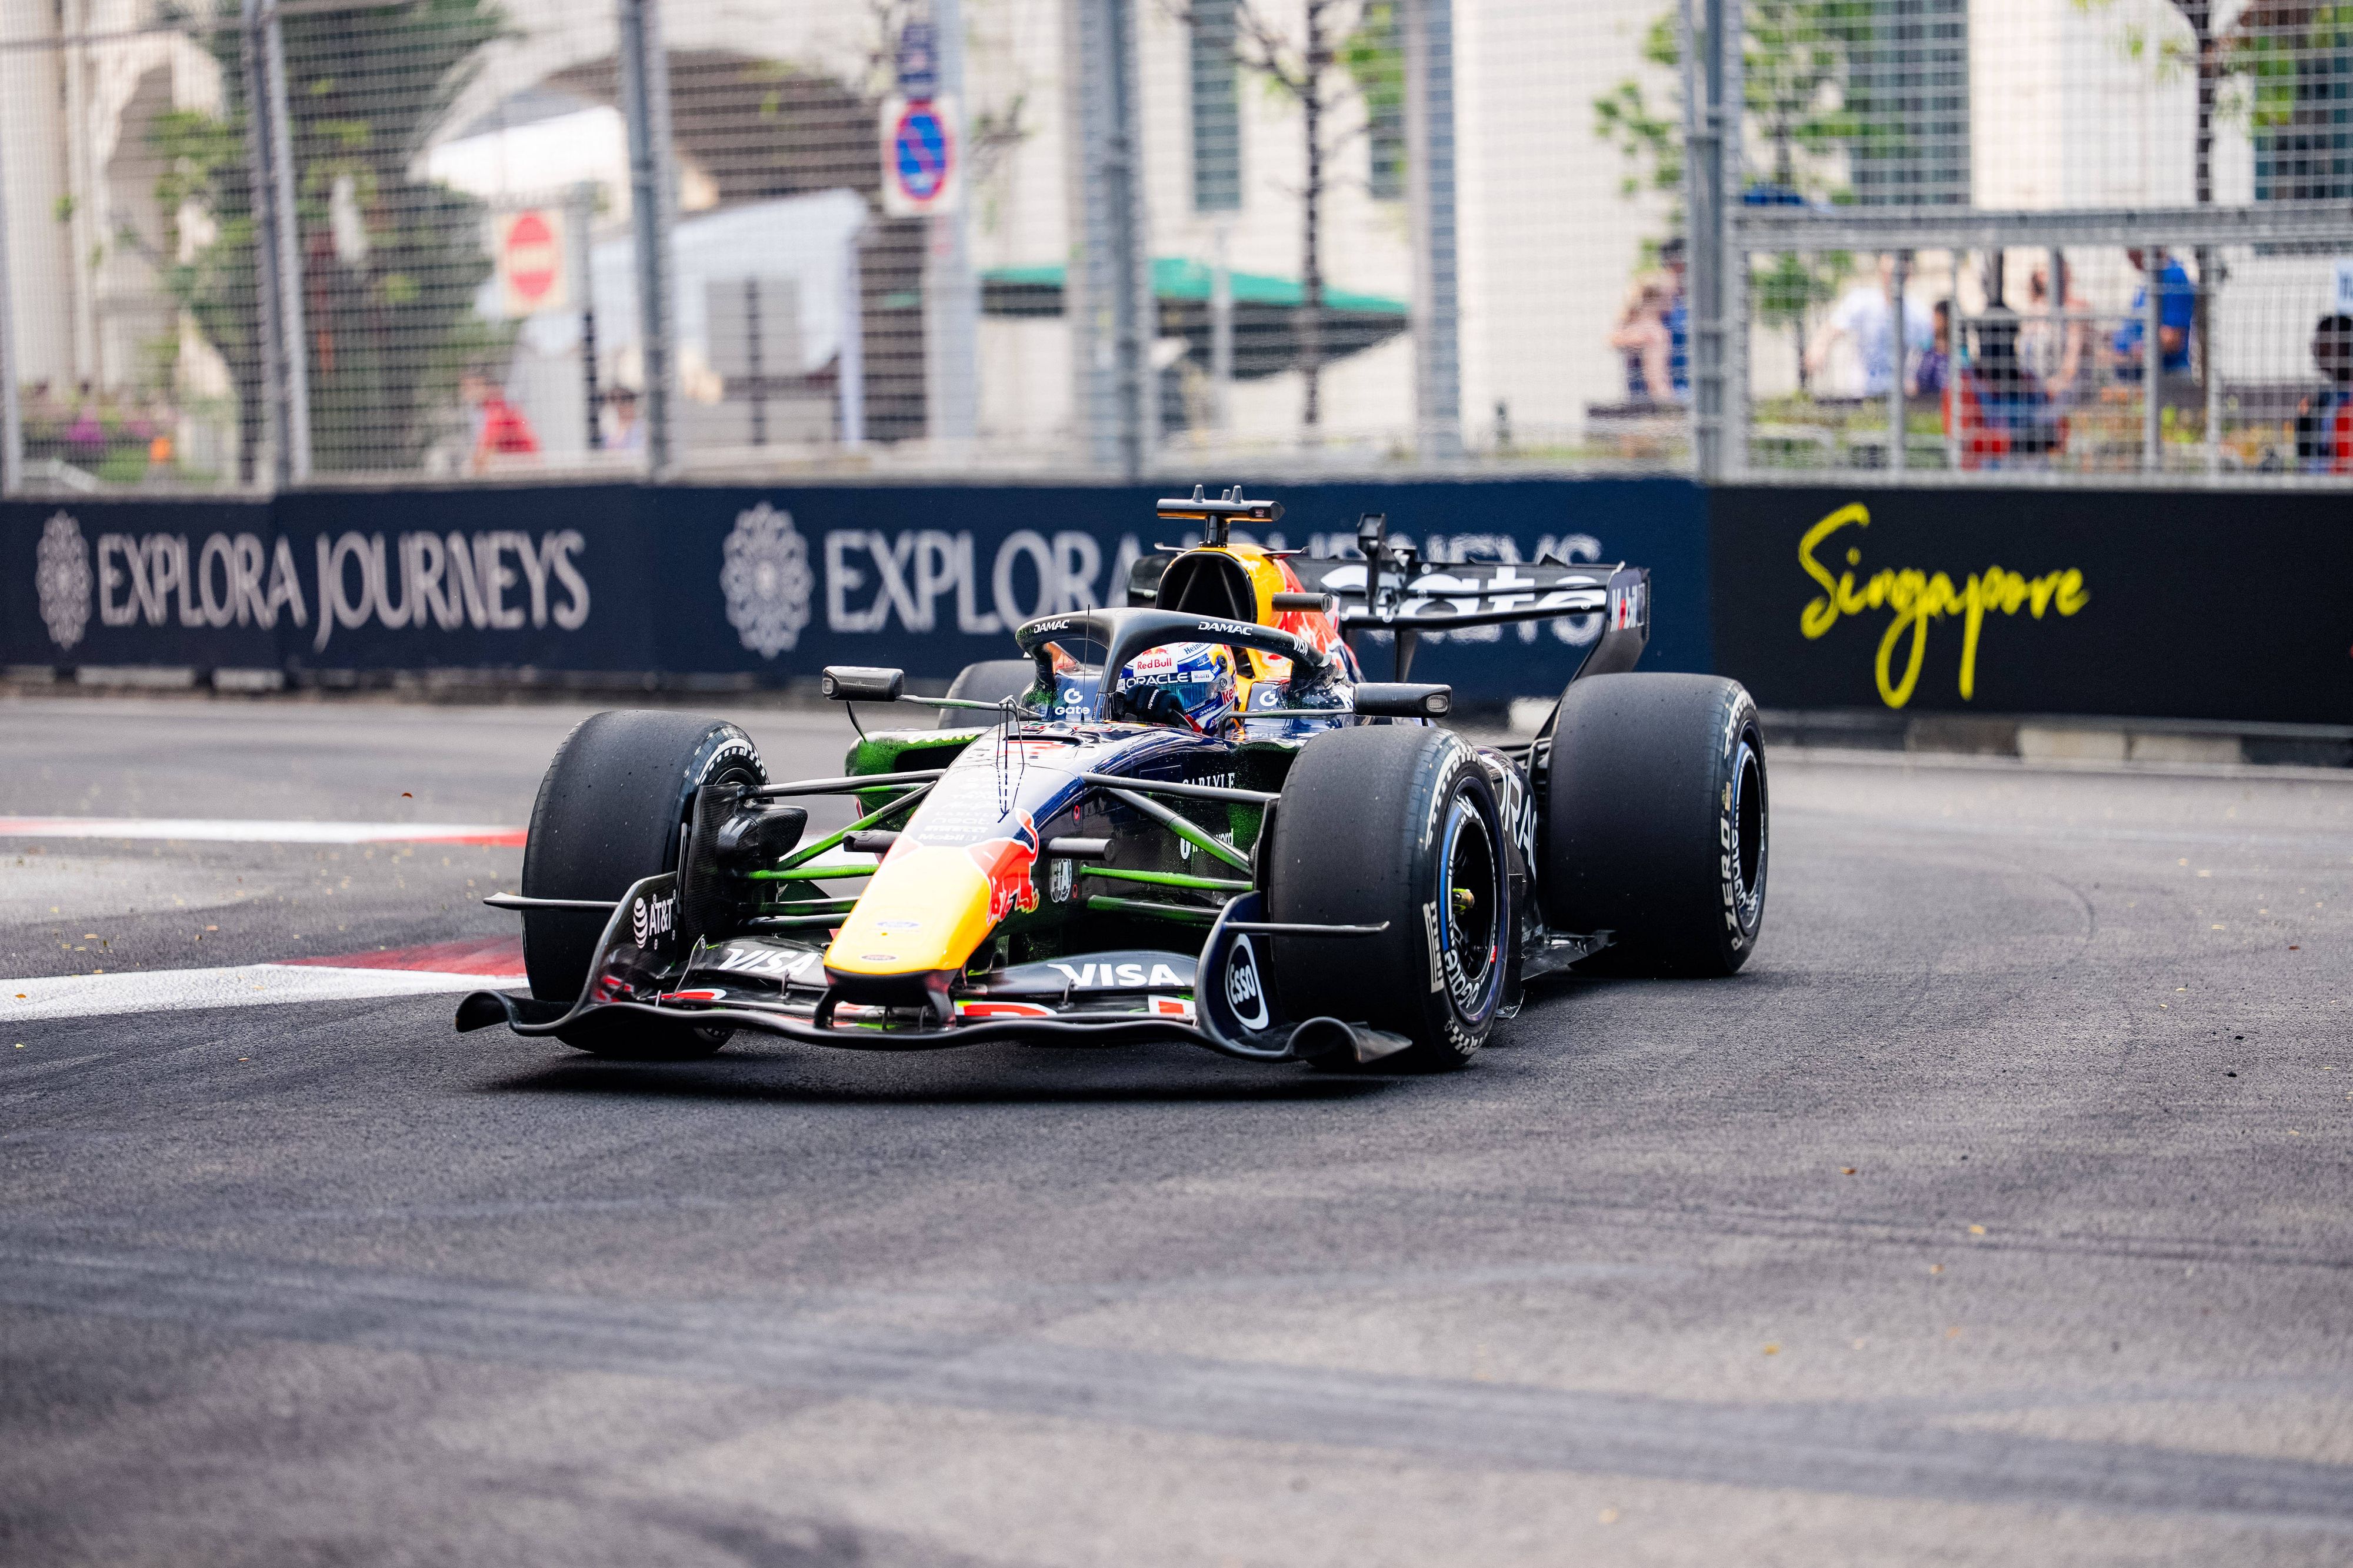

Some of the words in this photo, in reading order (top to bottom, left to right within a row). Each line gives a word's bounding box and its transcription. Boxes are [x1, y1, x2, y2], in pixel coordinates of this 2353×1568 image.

[98, 531, 308, 630] EXPLORA
[312, 528, 590, 653] JOURNEYS
[1798, 502, 2091, 709] Singapore
[1034, 619, 1070, 633] DAMAC
[1198, 621, 1253, 636] DAMAC
[1292, 635, 1309, 656] VISA
[1137, 660, 1153, 670] Red
[1154, 658, 1172, 668] Bull
[1126, 672, 1189, 688] ORACLE
[1720, 817, 1737, 930] ZERO
[648, 898, 675, 936] AT&T
[718, 947, 821, 976] VISA
[1046, 963, 1185, 987] VISA
